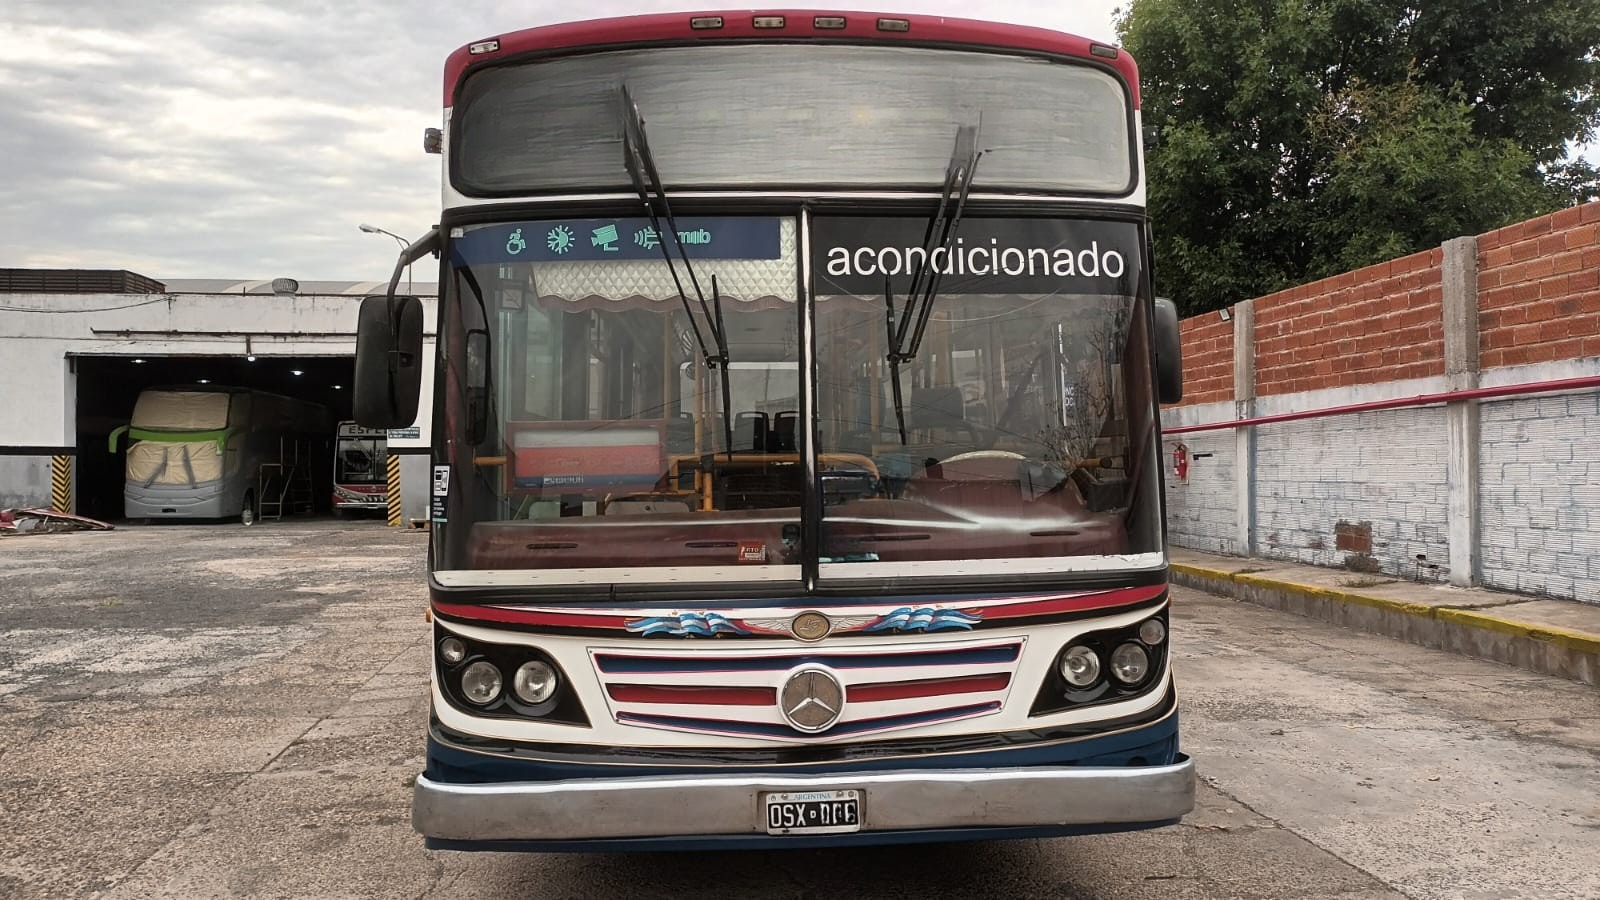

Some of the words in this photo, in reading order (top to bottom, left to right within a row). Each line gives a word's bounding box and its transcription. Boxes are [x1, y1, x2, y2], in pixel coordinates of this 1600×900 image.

[827, 238, 1124, 278] acondicionado
[794, 792, 831, 801] ARGENTINA
[770, 803, 806, 827] OSX
